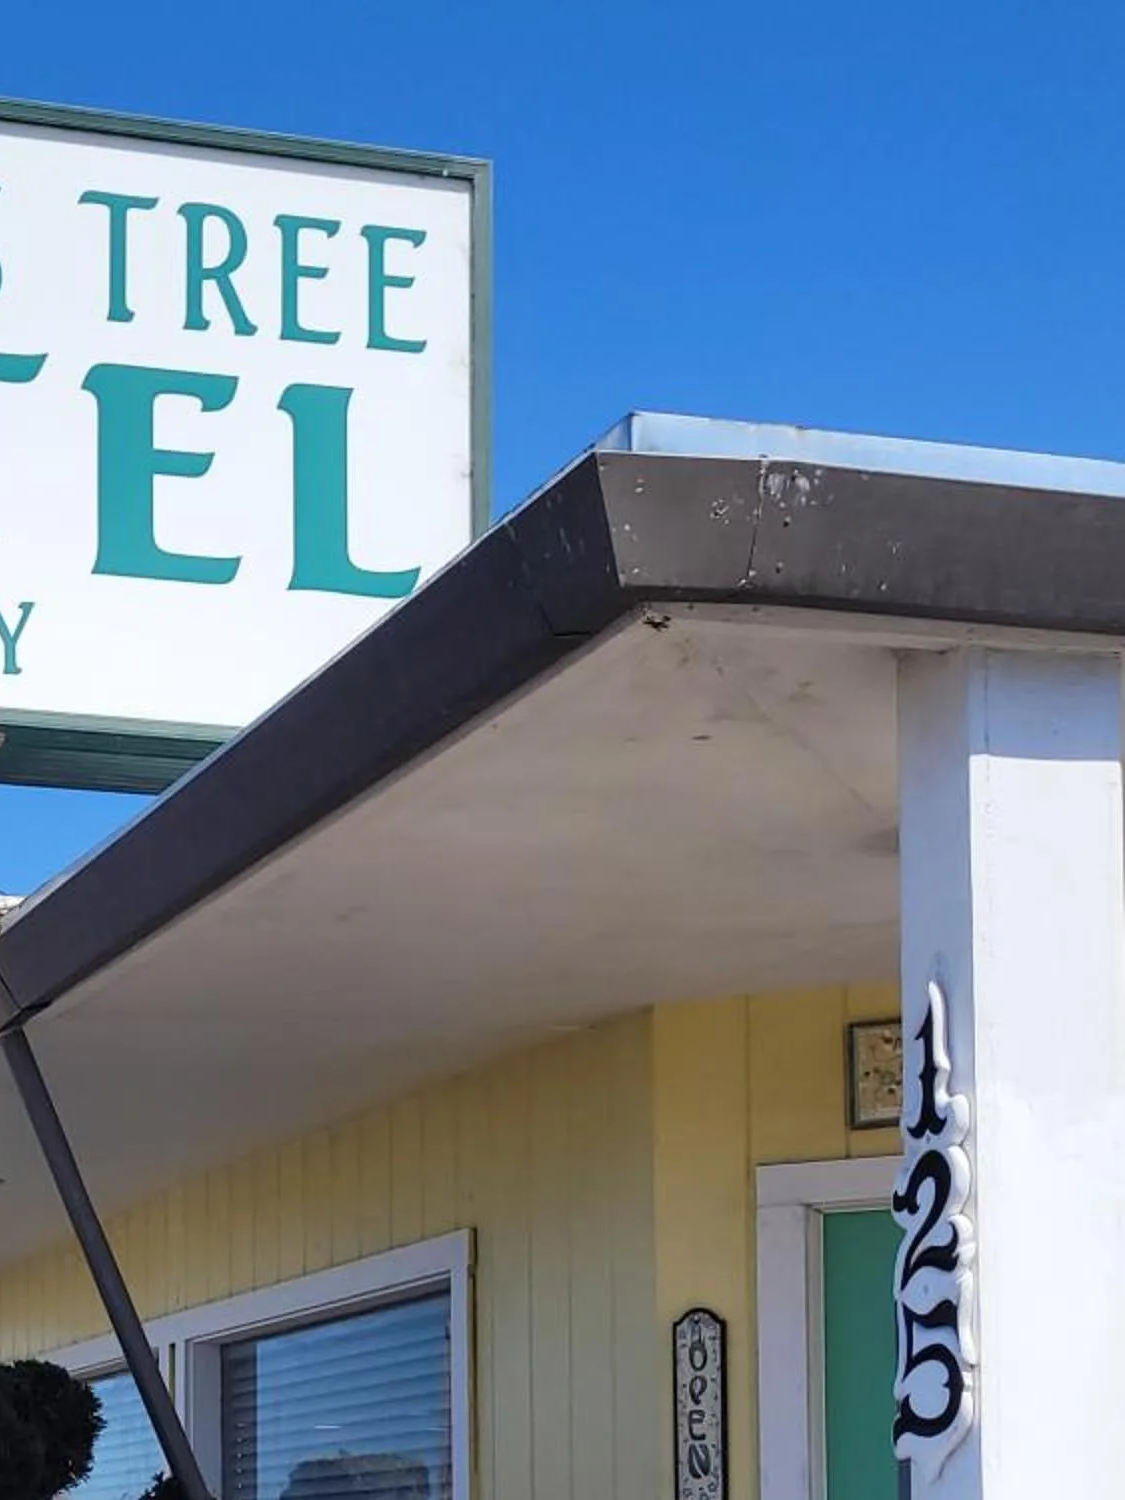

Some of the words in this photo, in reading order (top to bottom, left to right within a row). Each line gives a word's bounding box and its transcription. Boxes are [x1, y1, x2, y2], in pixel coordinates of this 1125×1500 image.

[77, 190, 427, 354] TREE
[892, 1005, 965, 1446] 125
[688, 1340, 712, 1481] OPEN
